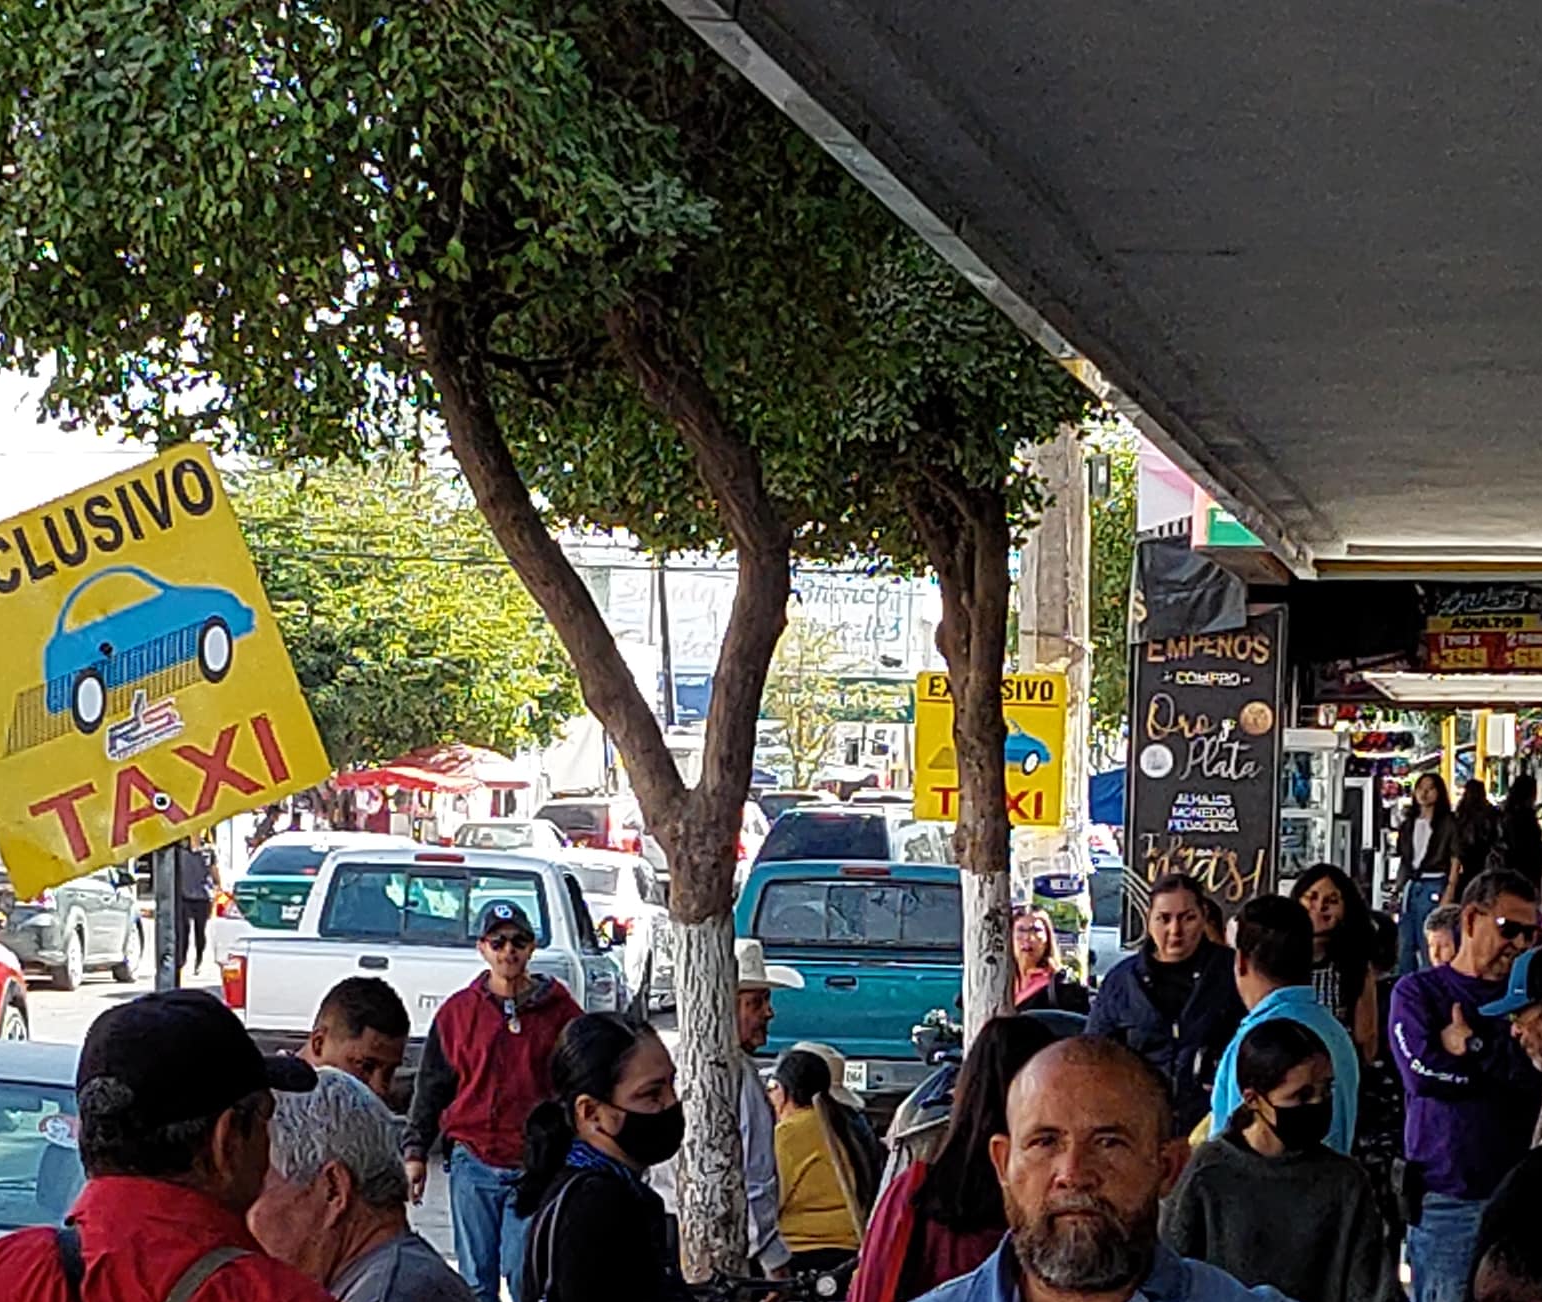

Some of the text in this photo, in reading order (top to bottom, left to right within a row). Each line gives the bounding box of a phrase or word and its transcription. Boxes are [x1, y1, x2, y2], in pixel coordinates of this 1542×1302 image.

[928, 675, 1054, 702] EXSIVO
[1146, 693, 1214, 740] Oro
[1179, 735, 1265, 781] Plata
[29, 712, 291, 864] TAXI
[931, 787, 1043, 820] TXI
